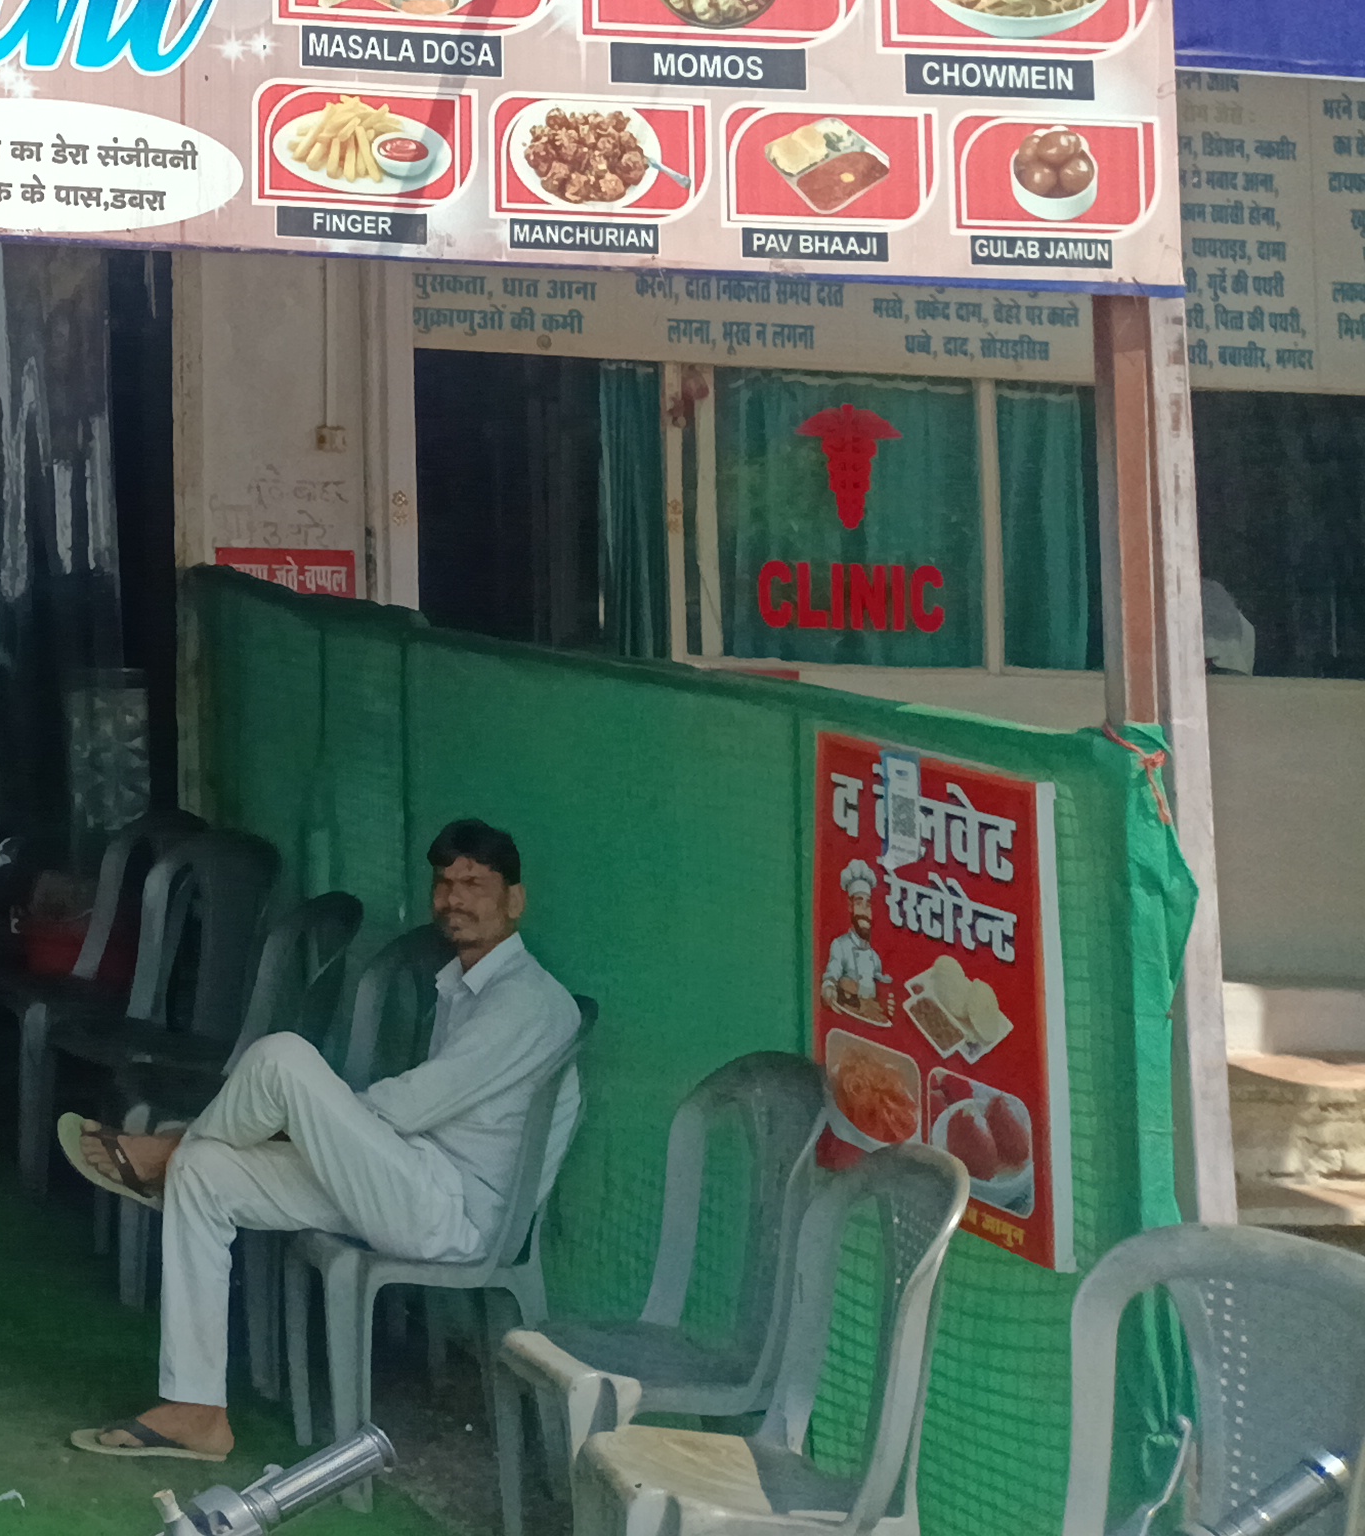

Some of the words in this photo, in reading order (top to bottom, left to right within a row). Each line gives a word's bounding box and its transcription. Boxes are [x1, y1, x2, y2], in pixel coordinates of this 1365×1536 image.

[307, 32, 415, 65] MASALA
[420, 38, 496, 68] DOSA
[653, 51, 764, 81] MOMOS
[922, 59, 1074, 92] CHOWMEIN
[10, 140, 43, 161] का
[51, 134, 90, 165] डेरा
[97, 137, 198, 170] संजीवनी
[20, 174, 46, 204] के
[312, 212, 393, 237] FINGER
[512, 221, 655, 250] MANCHURIAN
[751, 229, 793, 255] PAV
[798, 232, 880, 257] BHAAJI
[974, 237, 1039, 261] GULAB
[1041, 239, 1110, 263] JAMUN
[546, 279, 597, 302] आना
[510, 306, 536, 333] की
[541, 309, 584, 334] कमी
[771, 323, 815, 350] लगना
[757, 561, 945, 633] CLINIC
[831, 772, 863, 837] द
